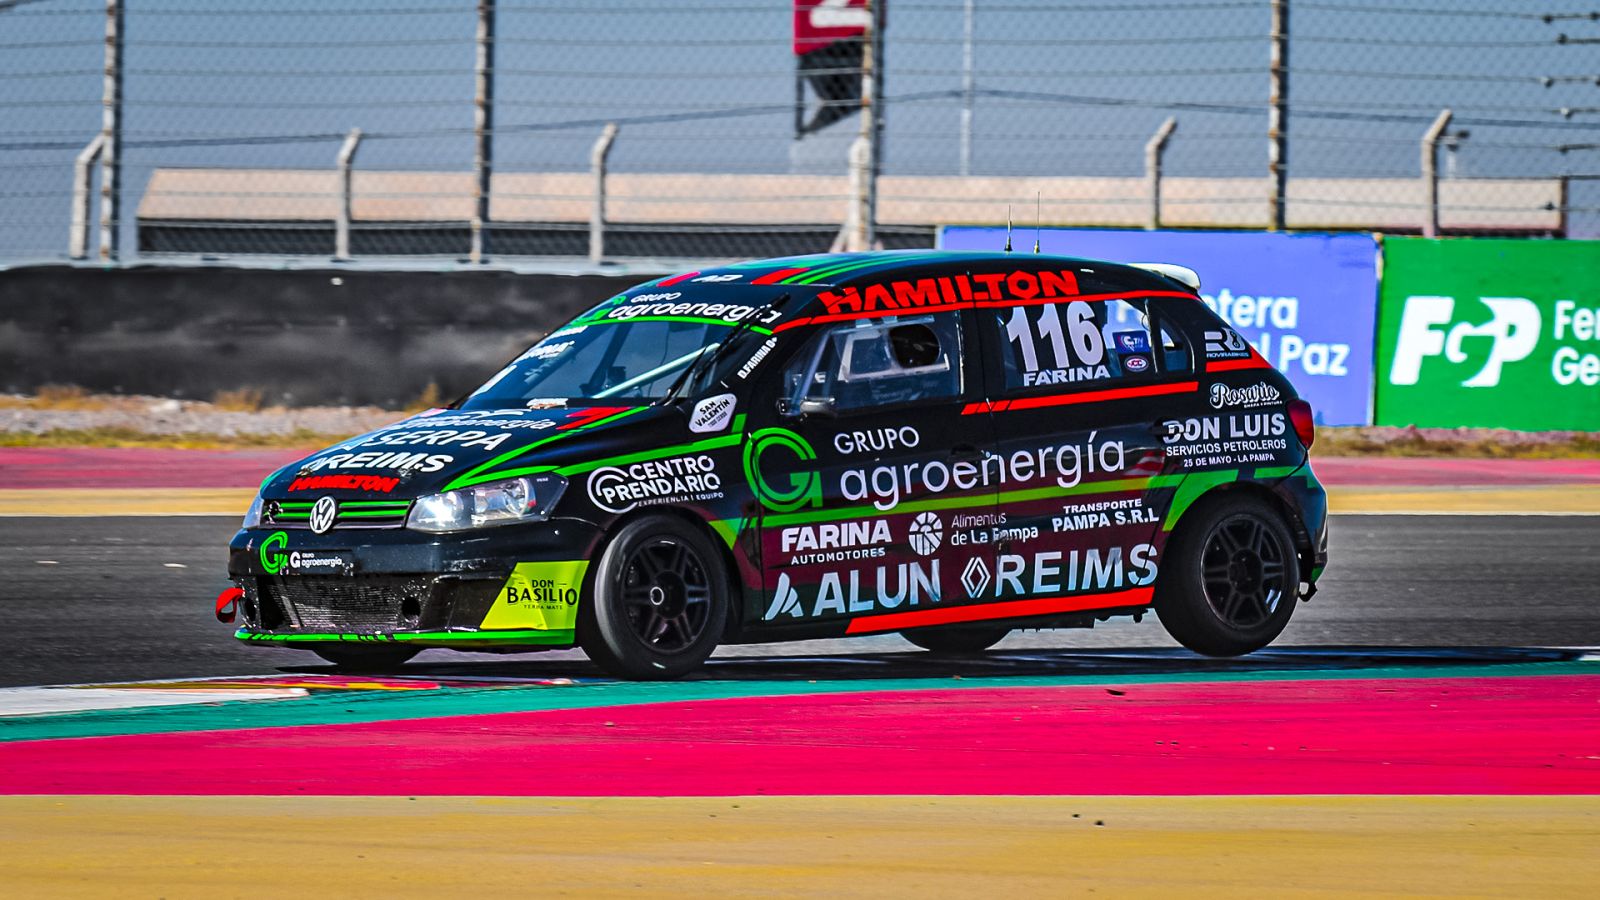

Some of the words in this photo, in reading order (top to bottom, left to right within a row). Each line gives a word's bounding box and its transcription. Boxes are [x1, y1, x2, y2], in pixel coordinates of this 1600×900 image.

[630, 292, 682, 303] GRUPO
[817, 270, 1079, 315] HAMILTON
[1006, 300, 1104, 372] 116
[1279, 335, 1350, 377] Paz
[1023, 365, 1111, 387] FARINA
[1209, 381, 1280, 409] Rosario
[694, 399, 730, 427] VALENTÍN
[699, 400, 717, 415] SAN
[834, 425, 920, 454] GRUPO
[1162, 418, 1220, 444] DON
[1229, 413, 1286, 438] LUIS
[361, 430, 513, 451] SERPA
[1166, 443, 1221, 456] SERVICIOS
[1223, 439, 1287, 452] PETROLEROS
[328, 452, 454, 472] REIMS
[629, 455, 715, 480] CENTRO
[840, 430, 1125, 511] agroenergía
[1184, 458, 1194, 468] 25
[1195, 457, 1208, 466] DE
[1208, 455, 1232, 464] MAYO
[1238, 455, 1248, 463] LA
[1249, 453, 1275, 462] PAMPA
[288, 475, 400, 493] HAMILTON
[602, 472, 721, 504] PRENDARIO
[696, 492, 724, 500] EQUIPO
[1063, 499, 1142, 514] TRANSPORTE
[951, 512, 1007, 528] Alimentos
[1052, 511, 1111, 533] PAMPA
[1114, 508, 1160, 526] S.R.L
[782, 520, 892, 553] FARINA
[951, 531, 968, 545] de
[970, 529, 988, 544] La
[791, 547, 886, 565] AUTOMOTORES
[995, 543, 1159, 597] REIMS
[531, 580, 554, 588] DON
[812, 559, 942, 617] ALUN
[506, 587, 578, 606] BASILIO
